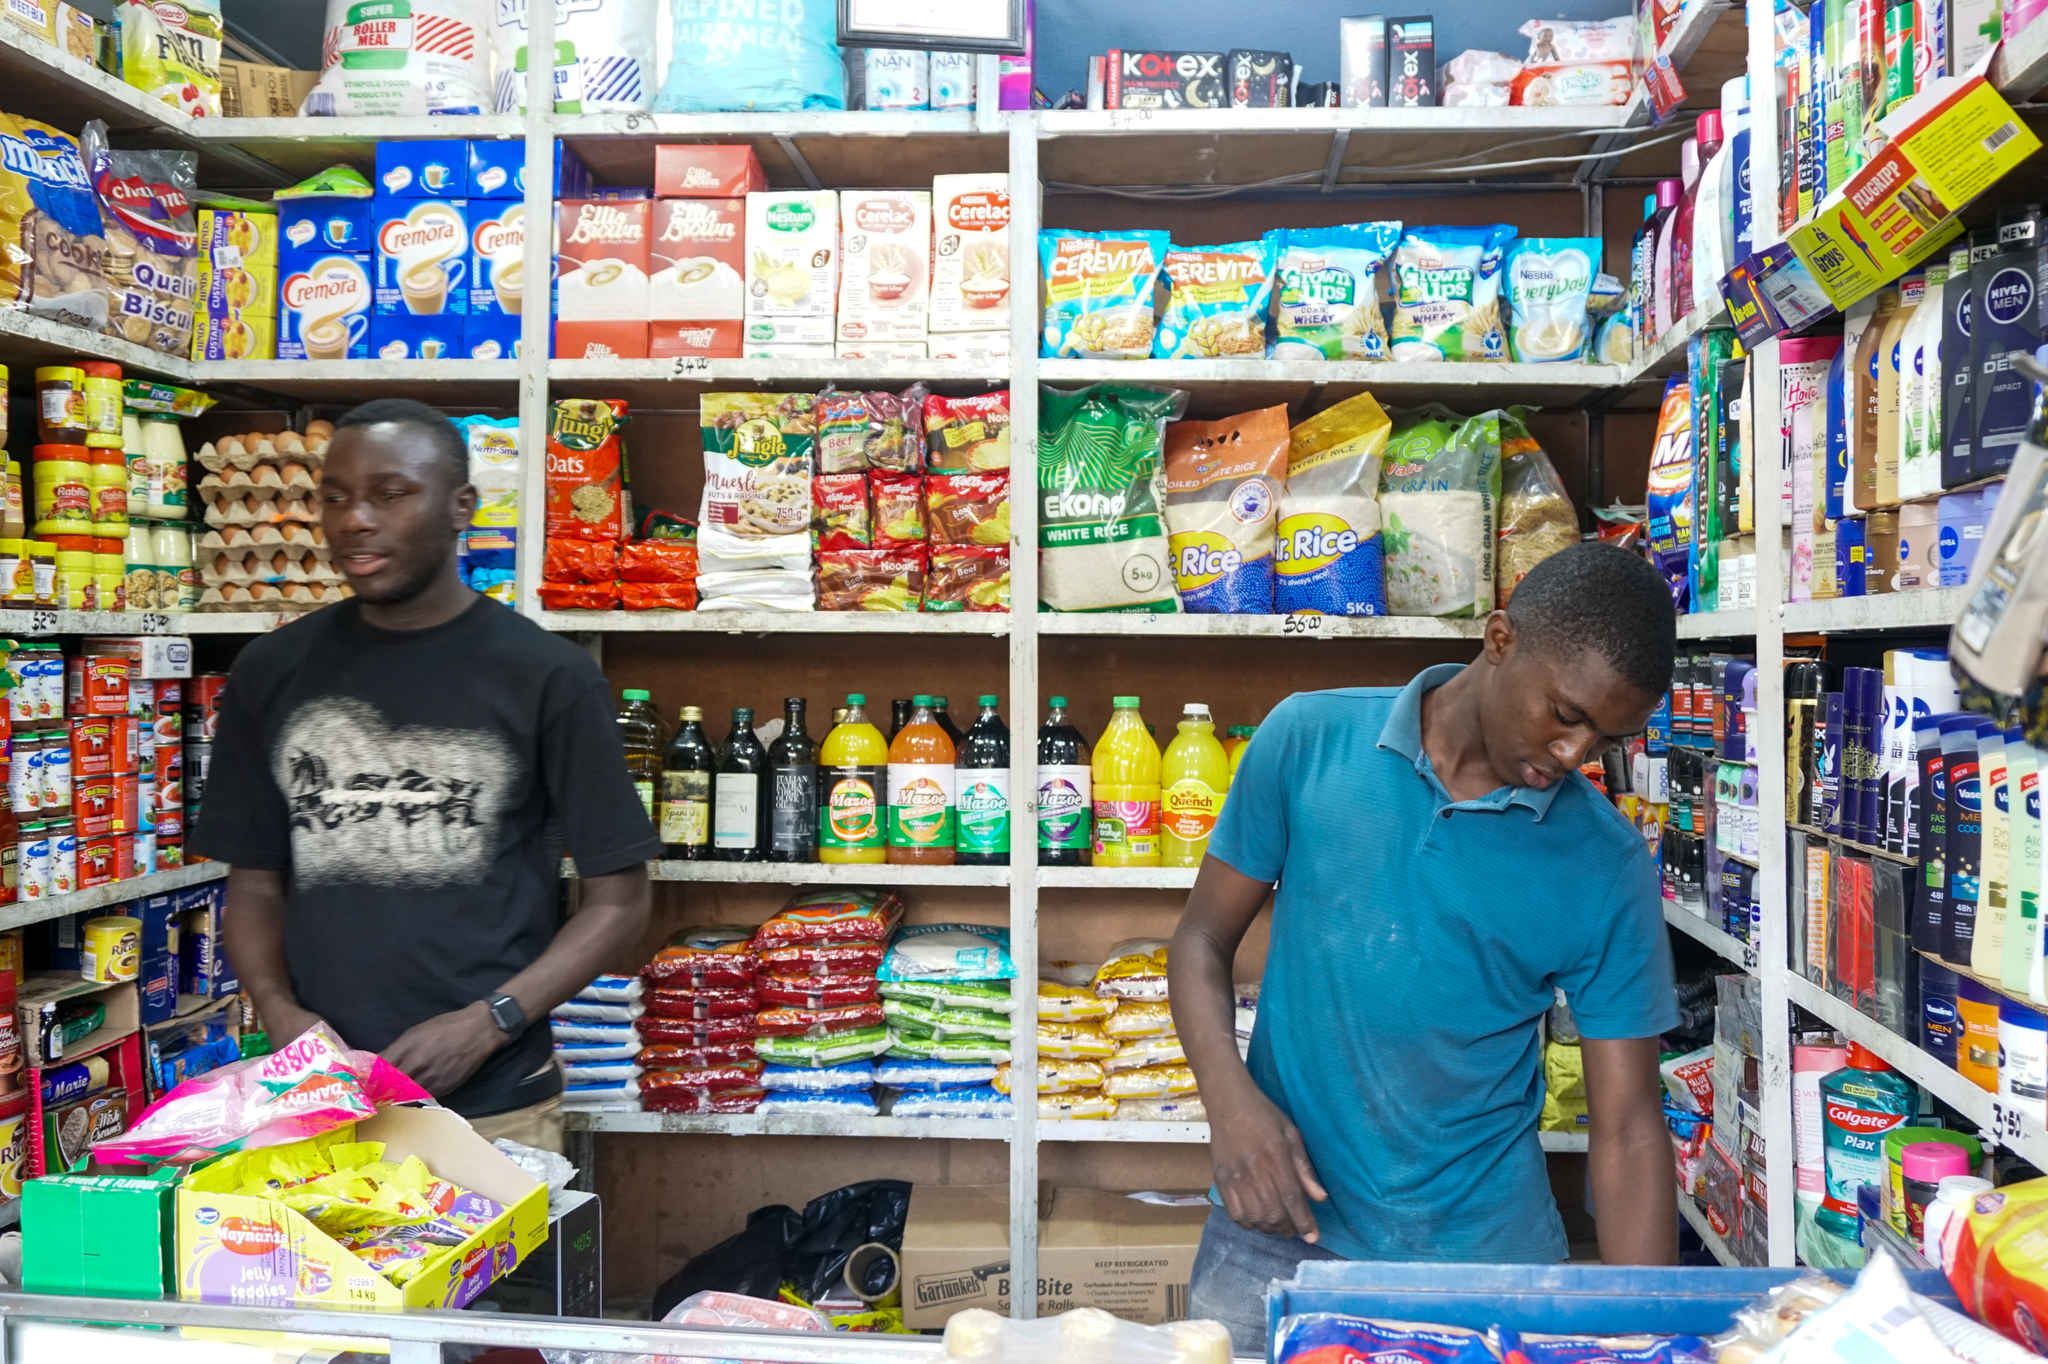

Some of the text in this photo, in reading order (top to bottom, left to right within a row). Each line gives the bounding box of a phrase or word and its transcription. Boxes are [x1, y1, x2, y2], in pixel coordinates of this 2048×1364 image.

[353, 22, 397, 36] ROLLER
[357, 34, 390, 46] MEAL
[911, 87, 921, 102] 2
[1851, 160, 1902, 211] FLUGRIPP
[579, 203, 628, 222] Ellis
[671, 201, 720, 221] Ellis
[857, 208, 912, 224] Cerelac
[949, 205, 1010, 222] Cerelac
[212, 215, 223, 249] USTARD
[378, 219, 455, 257] Cremora
[566, 218, 645, 243] Brown
[659, 219, 736, 242] Brown
[2001, 223, 2033, 240] NEW
[1050, 248, 1155, 279] CEREVITA
[1400, 264, 1473, 284] Grown
[211, 268, 222, 309] CUSTARD
[282, 272, 358, 310] Cremora
[1425, 279, 1468, 298] Ups
[1990, 284, 2029, 301] NIVEA
[1993, 295, 2024, 310] MEN
[1293, 314, 1335, 326] WHEAT
[1412, 312, 1456, 325] WHEAT
[208, 318, 219, 359] CUSTARD
[547, 453, 585, 474] Oats
[1233, 460, 1258, 473] RICE
[705, 469, 758, 492] Muesli
[1046, 523, 1130, 543] WHITE RICE
[1482, 516, 1494, 554] GRAIN
[1293, 527, 1359, 560] Rice
[957, 563, 978, 577] Beef
[1181, 545, 1242, 577] Rice
[1481, 556, 1492, 583] LONG
[1346, 602, 1375, 616] 5Kg
[1647, 728, 1661, 741] 50
[776, 774, 809, 785] ITALIAN
[1953, 767, 1969, 780] NEW
[896, 787, 947, 806] Mazoe
[959, 793, 1008, 811] Mazoe
[1169, 794, 1213, 808] Quench
[1927, 1022, 1952, 1034] MEN
[262, 1038, 328, 1079] BOBBY
[53, 1074, 91, 1101] Marie
[286, 1081, 343, 1107] DANDY
[1828, 1106, 1888, 1128] Colgate
[1844, 1134, 1876, 1152] Plax
[215, 1225, 290, 1246] Maynards
[1095, 1259, 1169, 1268] KEEP REFRIGERATED
[240, 1266, 273, 1284] jelly
[229, 1282, 288, 1300] teddies
[917, 1276, 981, 1304] Garfunkels
[1047, 1301, 1075, 1312] Rolls
